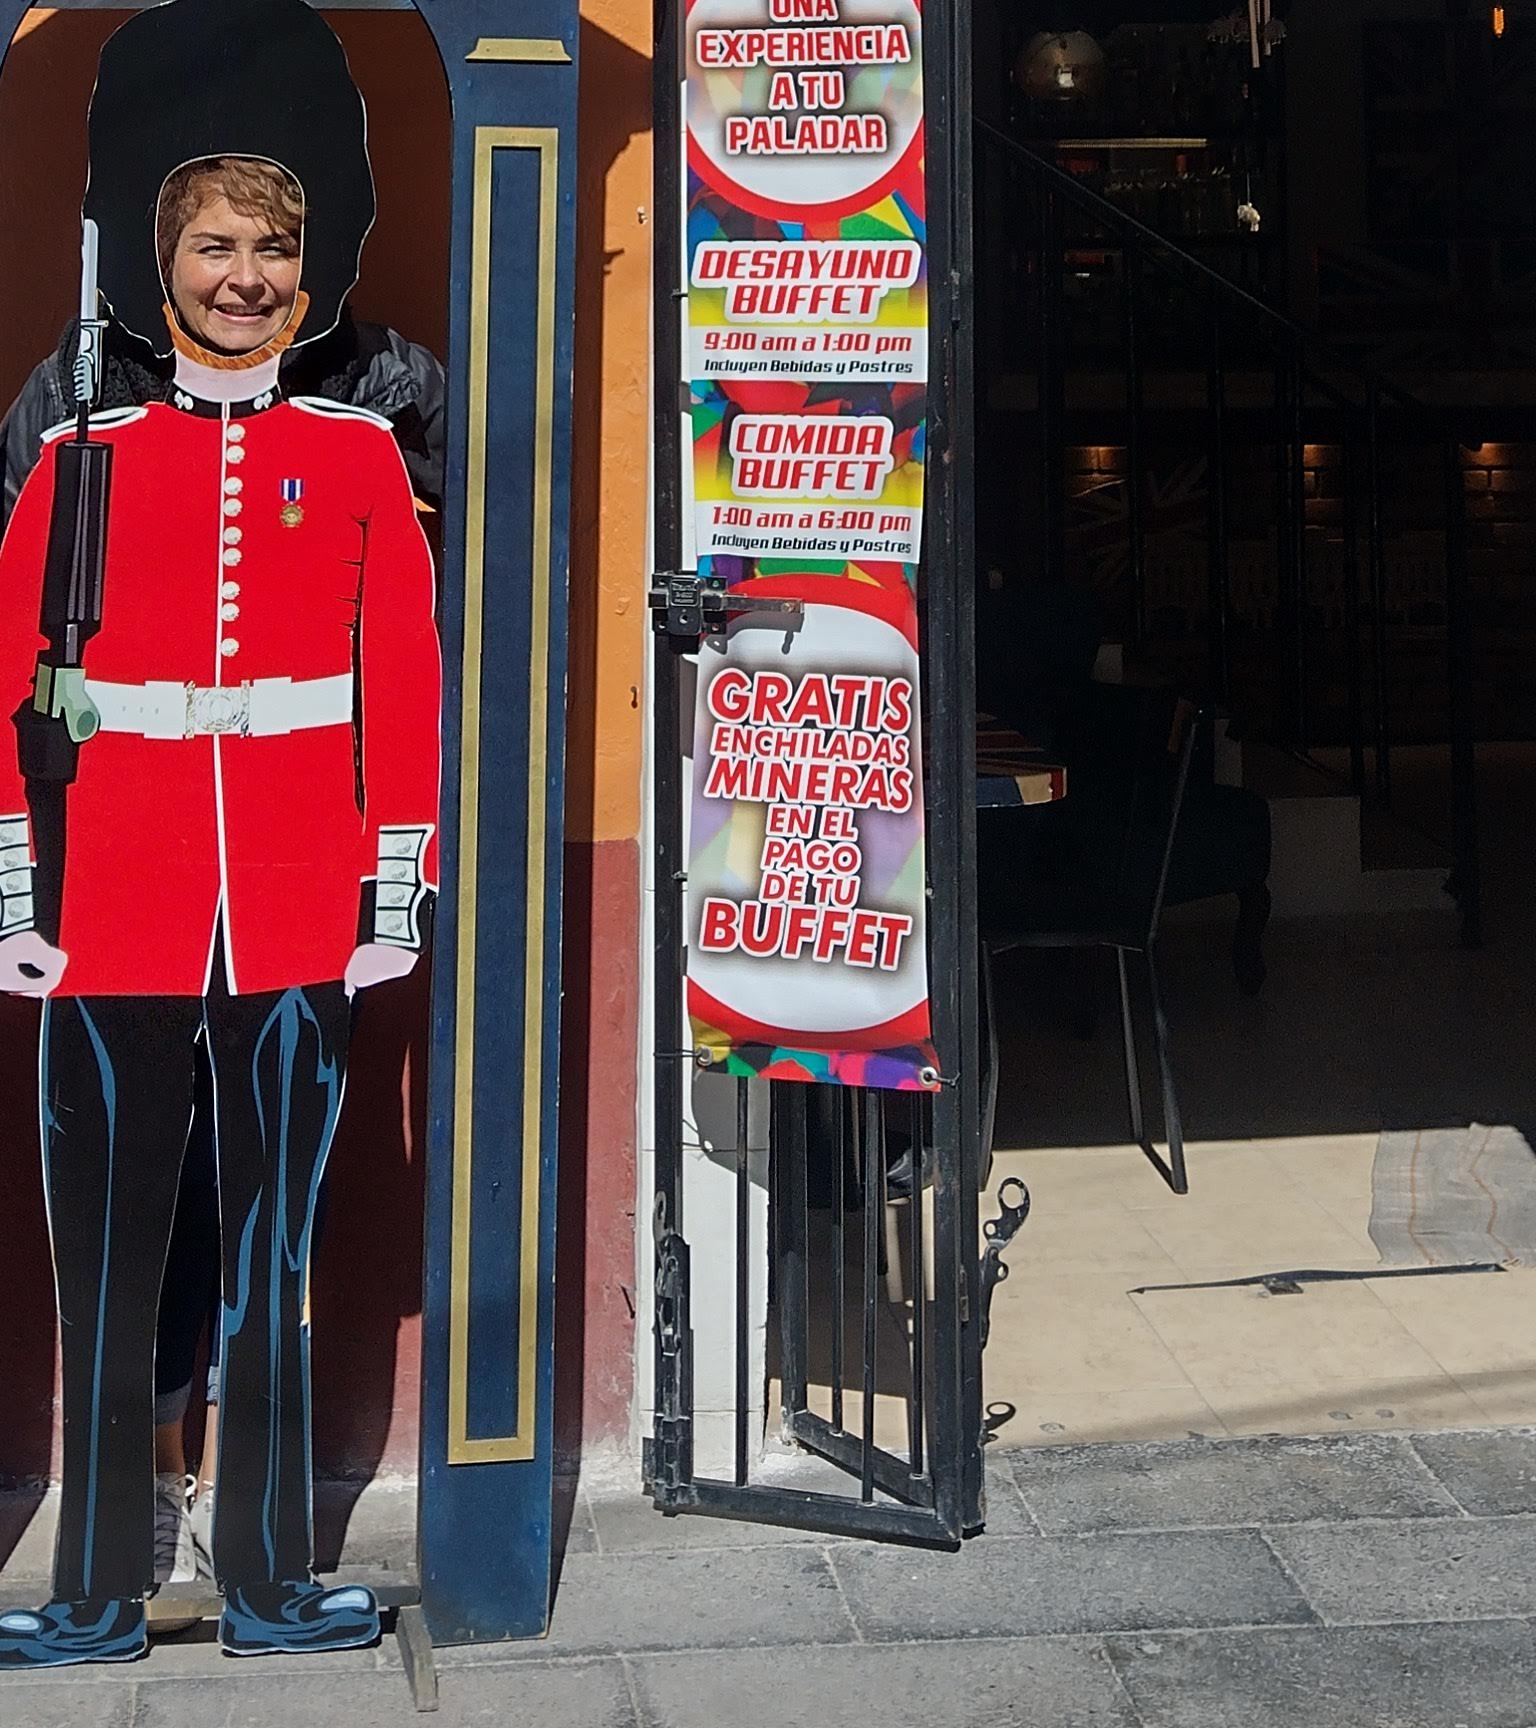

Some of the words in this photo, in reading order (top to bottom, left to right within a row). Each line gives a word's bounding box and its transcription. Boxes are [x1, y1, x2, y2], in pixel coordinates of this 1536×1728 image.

[700, 28, 908, 64] EXPERIENCIA
[771, 74, 796, 108] A
[801, 73, 843, 107] TU
[728, 117, 886, 152] PALADAR
[699, 250, 914, 280] DESAYUNO
[731, 285, 882, 315] BUFFET
[704, 332, 757, 351] 9:00
[761, 336, 797, 352] am
[802, 336, 816, 352] a
[823, 333, 871, 352] 1:00
[875, 336, 912, 355] pm
[704, 359, 768, 374] Incluyen
[770, 359, 833, 373] Bebidas
[836, 362, 847, 375] y
[848, 360, 914, 374] Postres
[736, 423, 884, 455] COMIDA
[737, 459, 886, 491] BUFFET
[713, 506, 752, 526] 1:00
[756, 512, 794, 529] am
[798, 512, 813, 530] a
[818, 510, 875, 531] 6:00
[878, 514, 912, 534] pm
[711, 533, 769, 551] Incluyen
[771, 536, 837, 551] Bebidas
[840, 540, 850, 554] y
[852, 538, 912, 554] Postres
[708, 669, 912, 733] GRATIS
[714, 725, 910, 766] ENCHILADAS
[706, 758, 913, 811] MINERAS
[768, 806, 812, 838] EN
[820, 809, 857, 840] EL
[762, 841, 862, 875] PAGO
[760, 874, 805, 904] DE
[814, 876, 858, 908] TU
[701, 898, 912, 971] BUFFET
